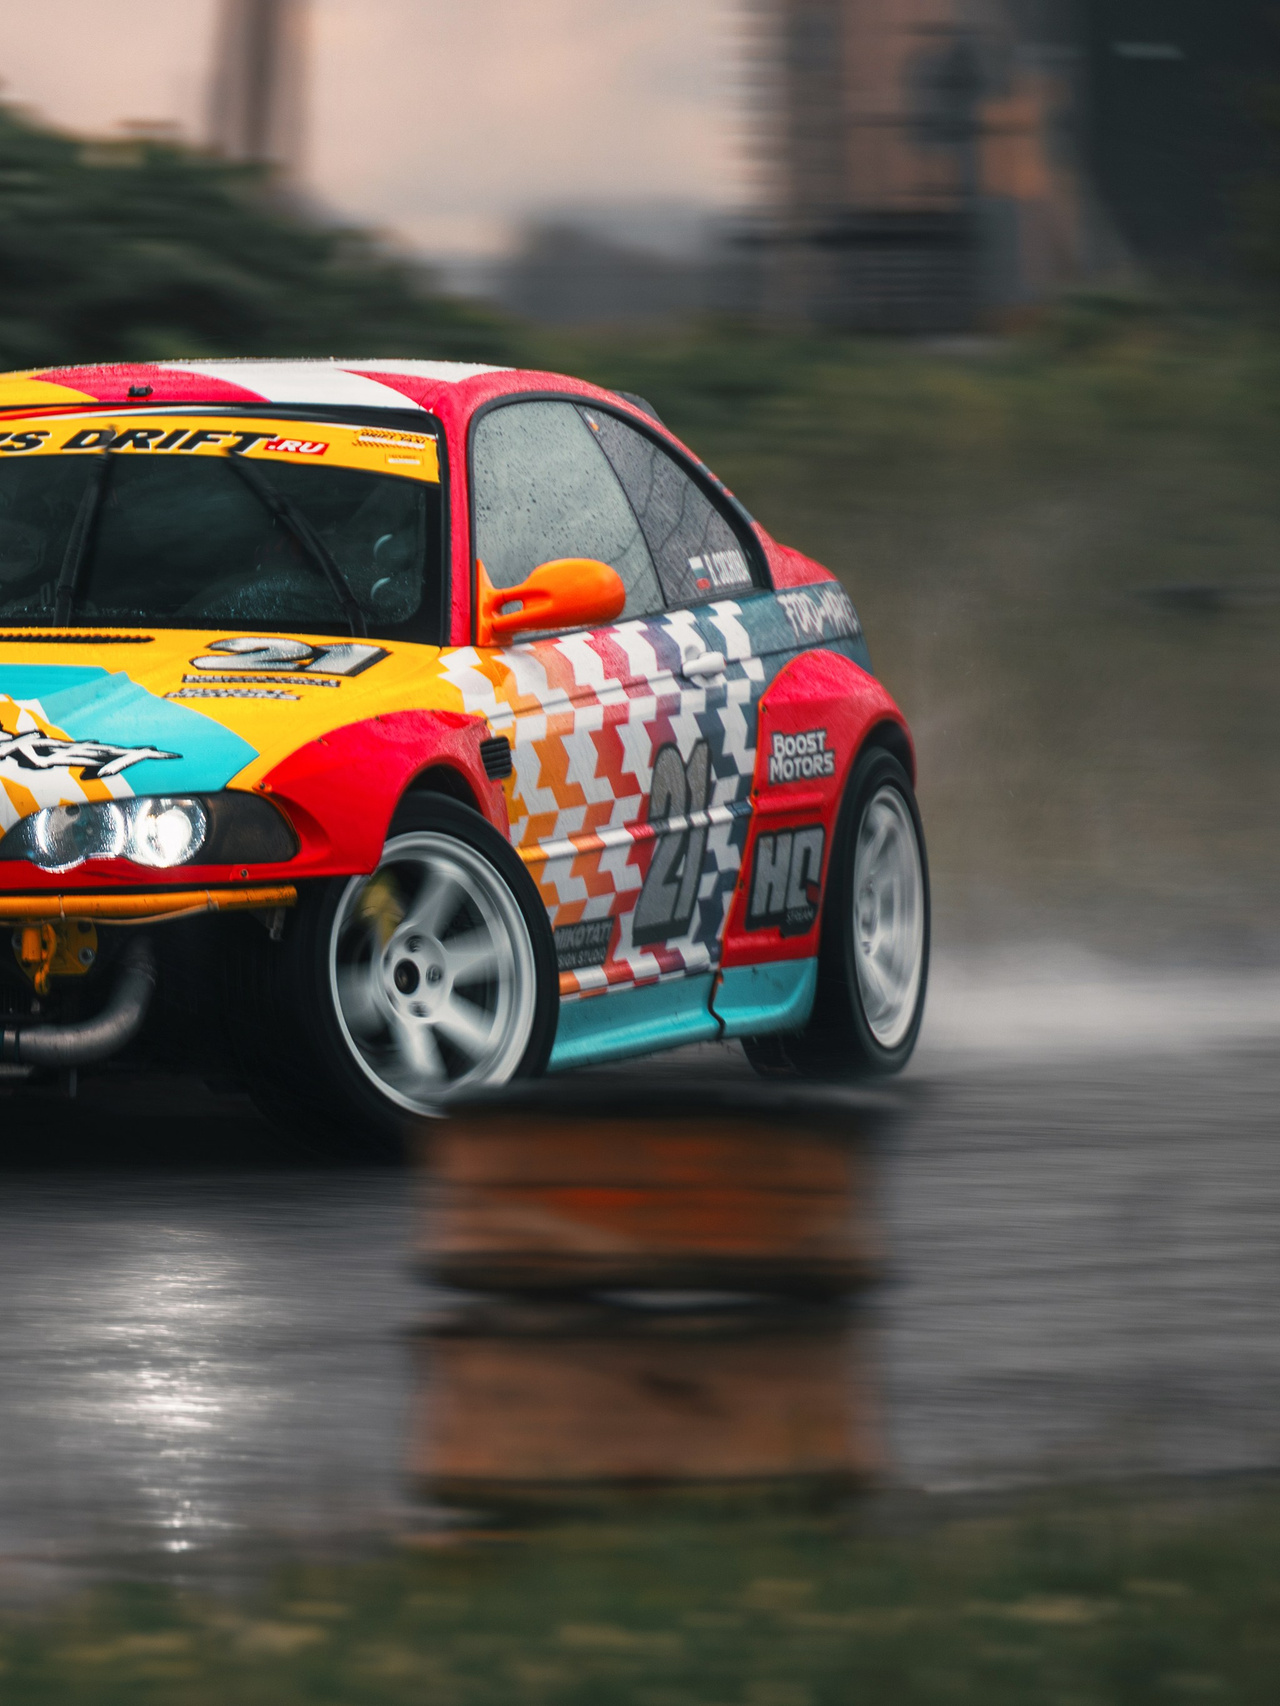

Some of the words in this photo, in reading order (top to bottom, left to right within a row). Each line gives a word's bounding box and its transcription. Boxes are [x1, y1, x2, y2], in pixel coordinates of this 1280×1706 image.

[60, 428, 282, 459] DRIFT
[188, 636, 394, 677] 21
[772, 730, 827, 758] BOOST
[768, 750, 835, 784] MOTORS
[632, 738, 711, 946] 21
